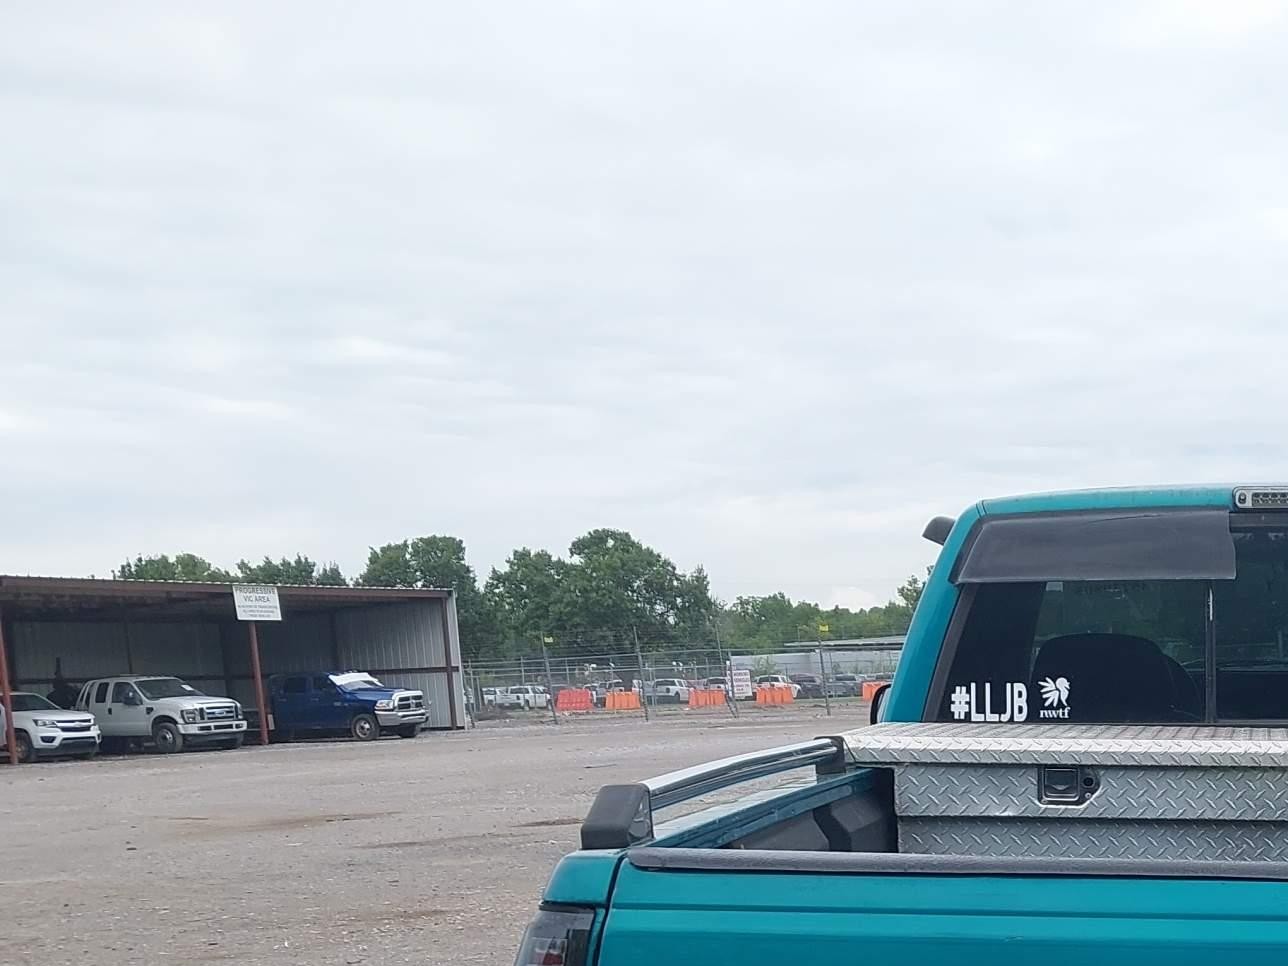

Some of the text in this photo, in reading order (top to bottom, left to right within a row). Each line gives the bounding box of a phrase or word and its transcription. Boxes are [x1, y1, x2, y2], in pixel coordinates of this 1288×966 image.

[234, 586, 277, 595] PROGRESSIVE
[255, 595, 271, 603] AREA
[950, 682, 1028, 722] #LLJB
[1039, 706, 1071, 719] nwtf
